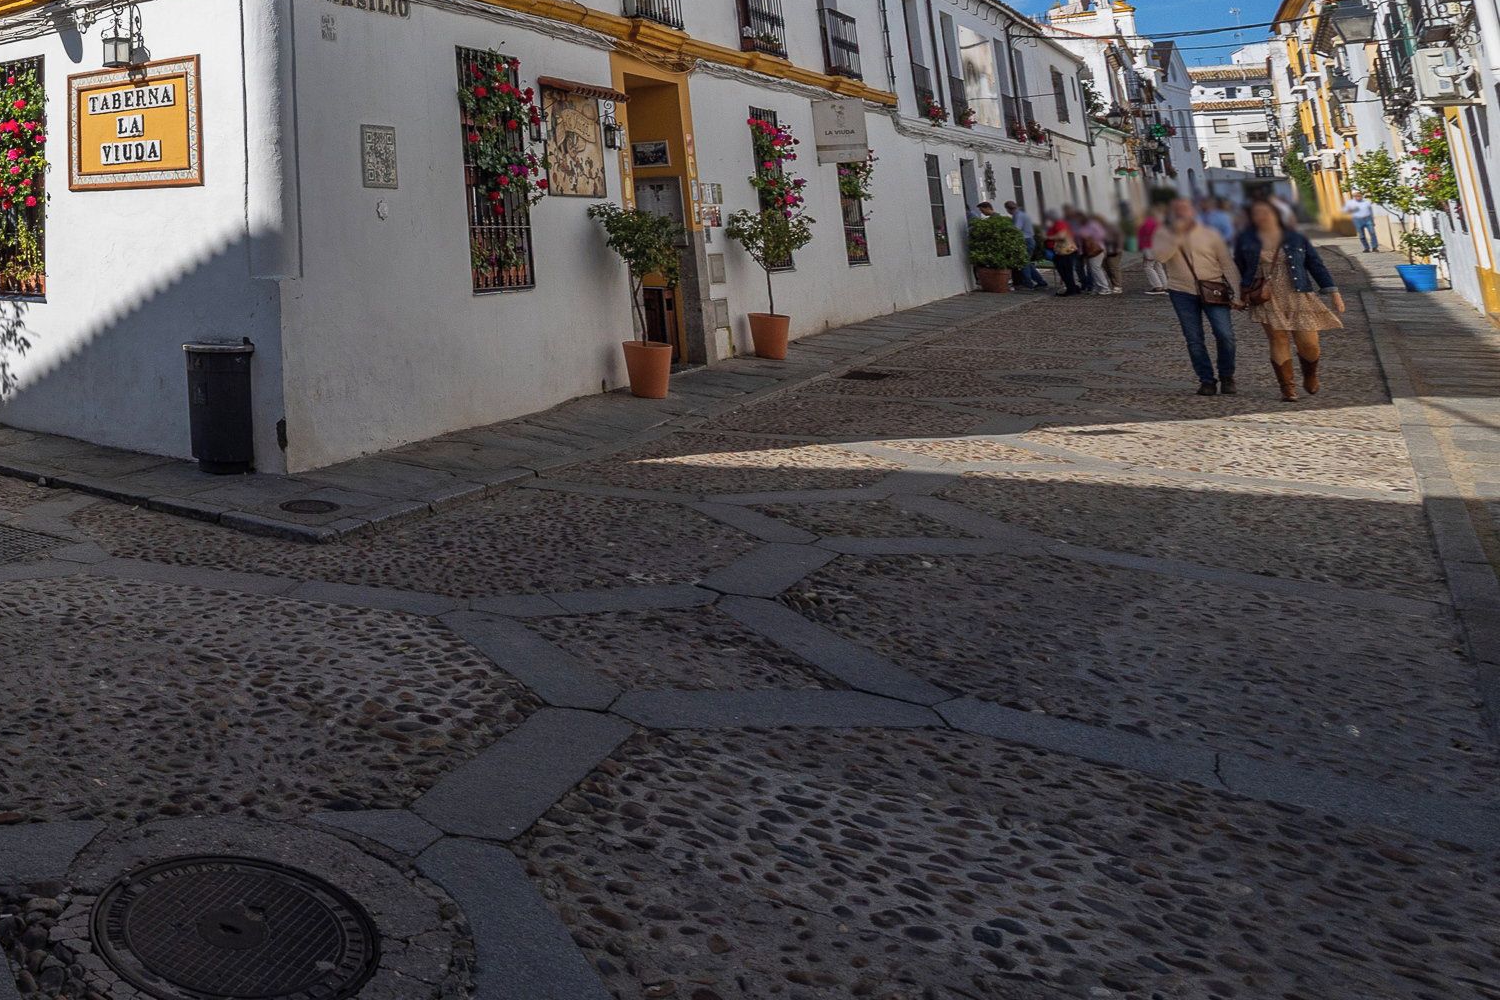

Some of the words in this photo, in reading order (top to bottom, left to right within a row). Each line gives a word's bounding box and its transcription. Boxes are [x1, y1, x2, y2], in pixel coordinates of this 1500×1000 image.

[88, 86, 173, 113] TABERNA
[117, 116, 143, 136] LA
[102, 141, 159, 162] VIUDA
